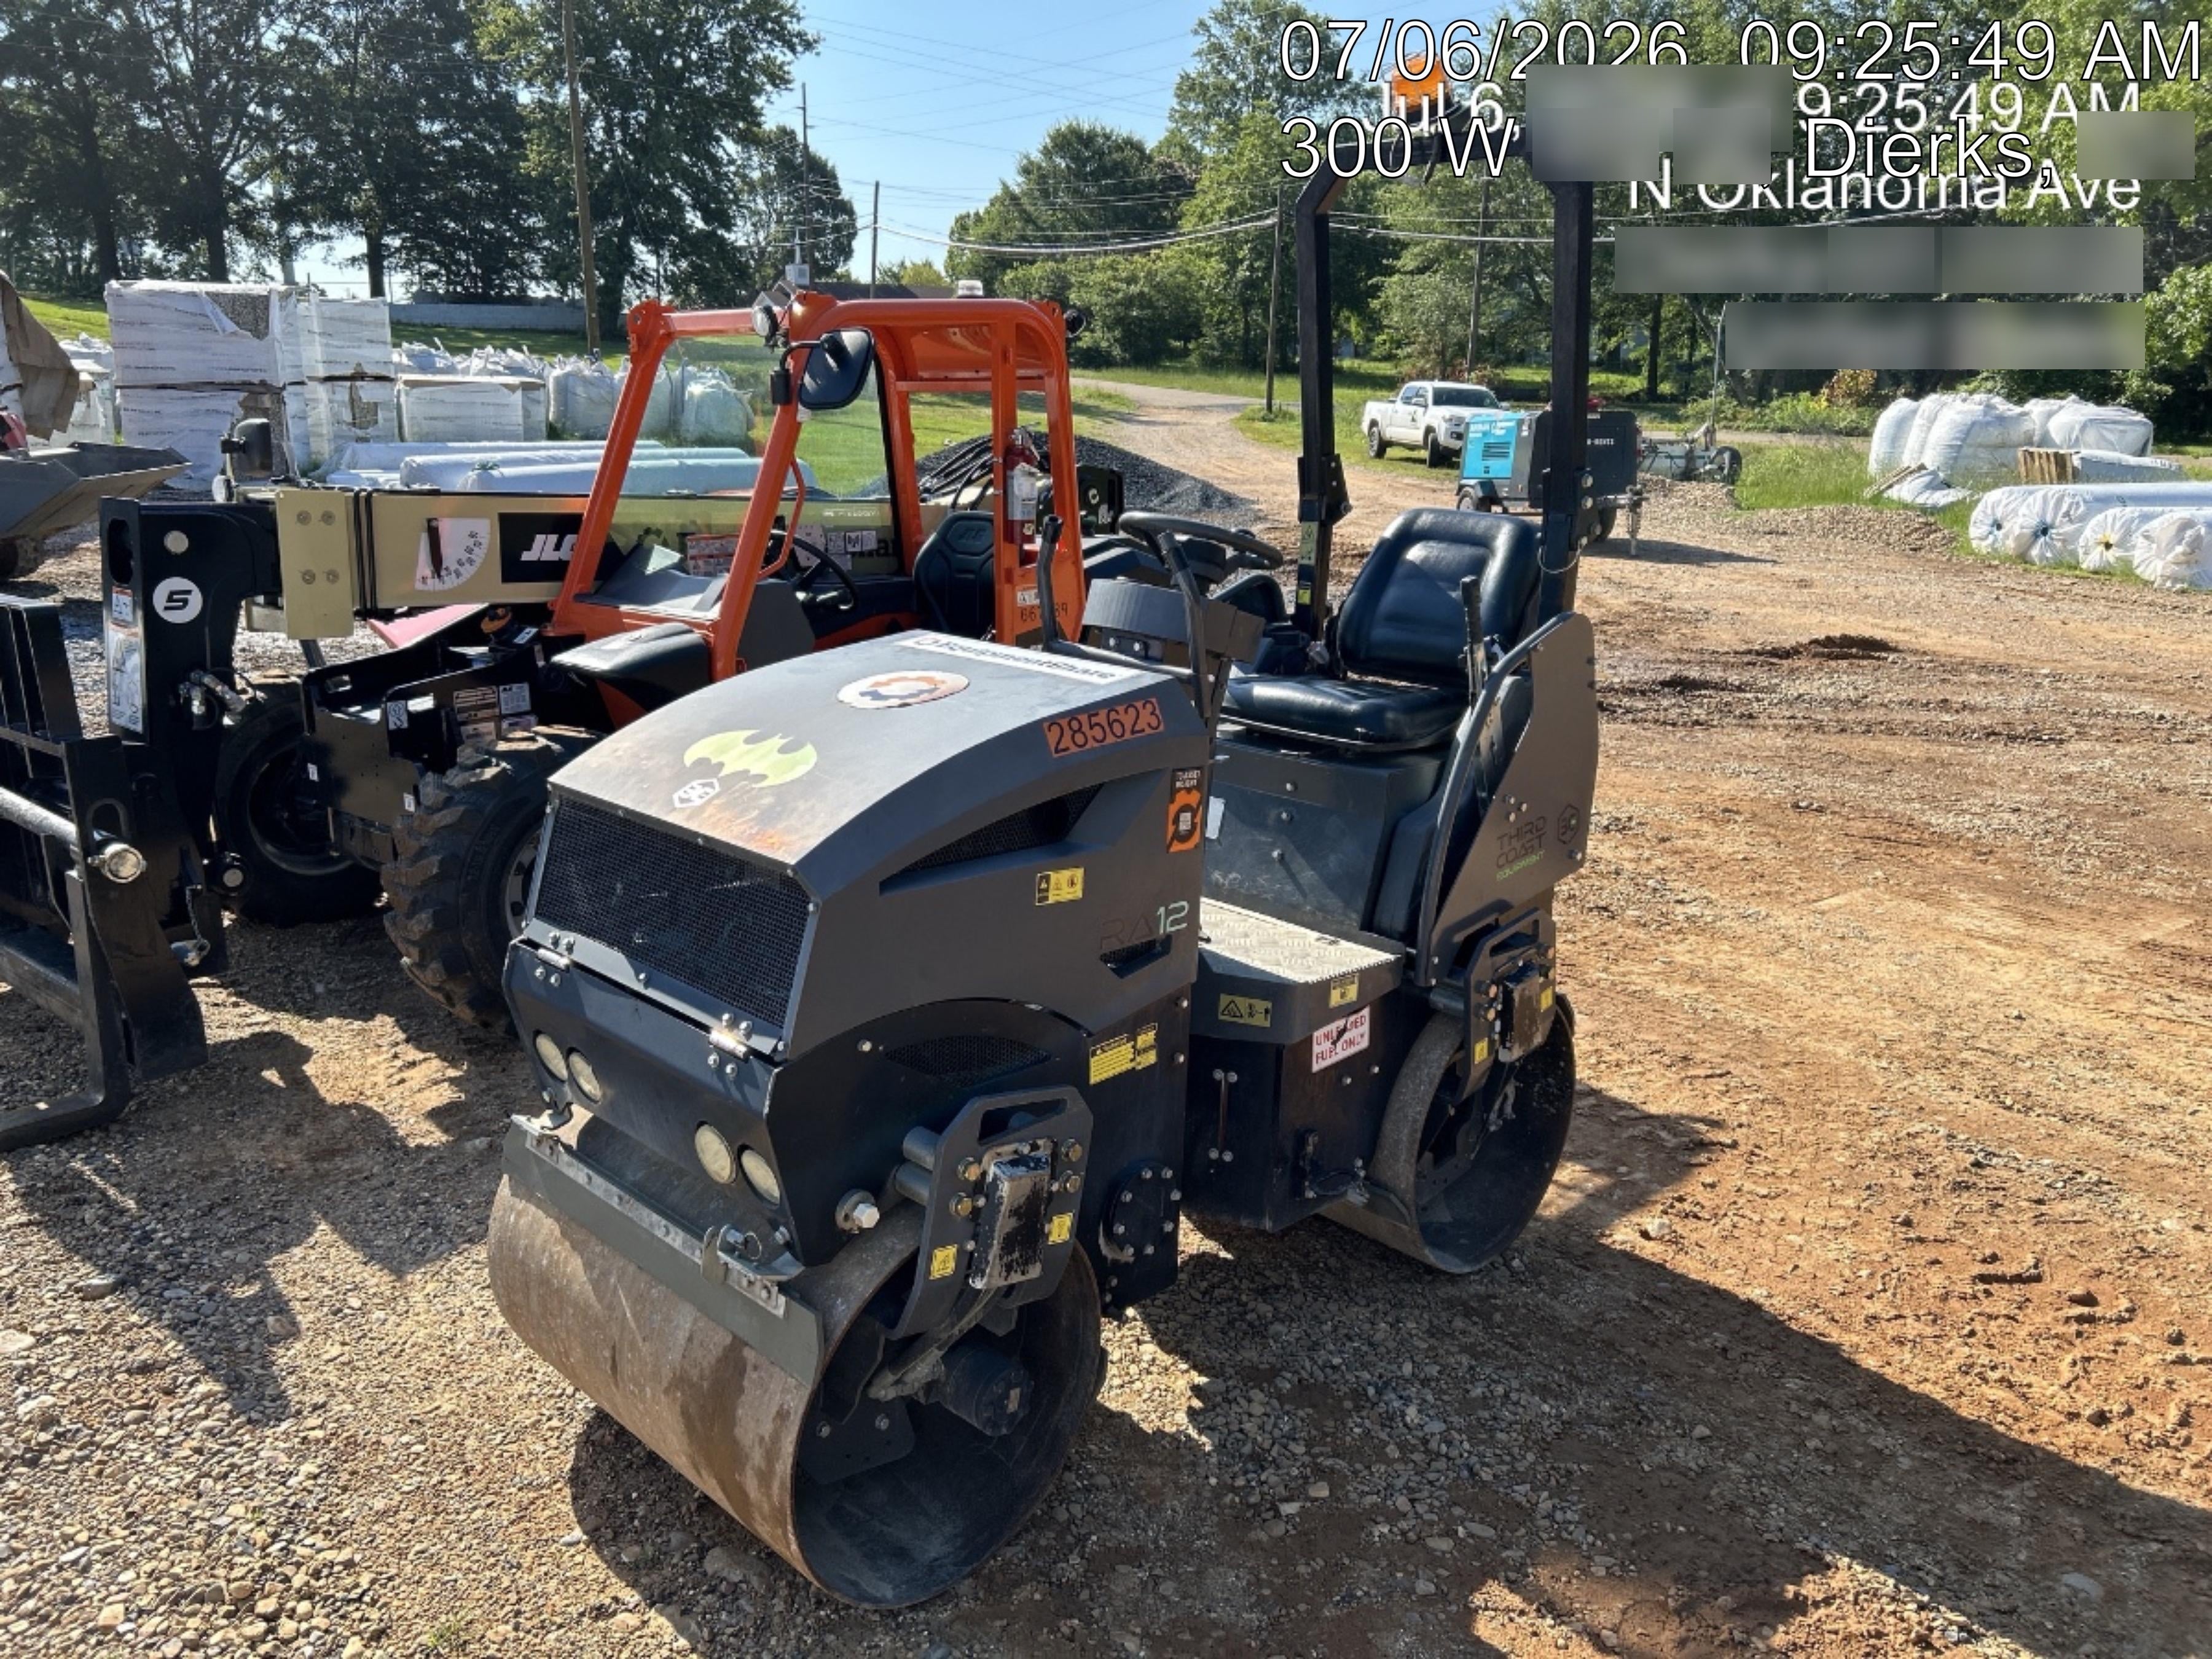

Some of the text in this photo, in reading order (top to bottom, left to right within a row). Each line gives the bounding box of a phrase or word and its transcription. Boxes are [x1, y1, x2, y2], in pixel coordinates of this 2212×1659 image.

[1046, 700, 1161, 755] 285623
[1496, 831, 1547, 869] COAST
[1497, 816, 1547, 850] THIRD
[1316, 1015, 1367, 1046] UNLEDED
